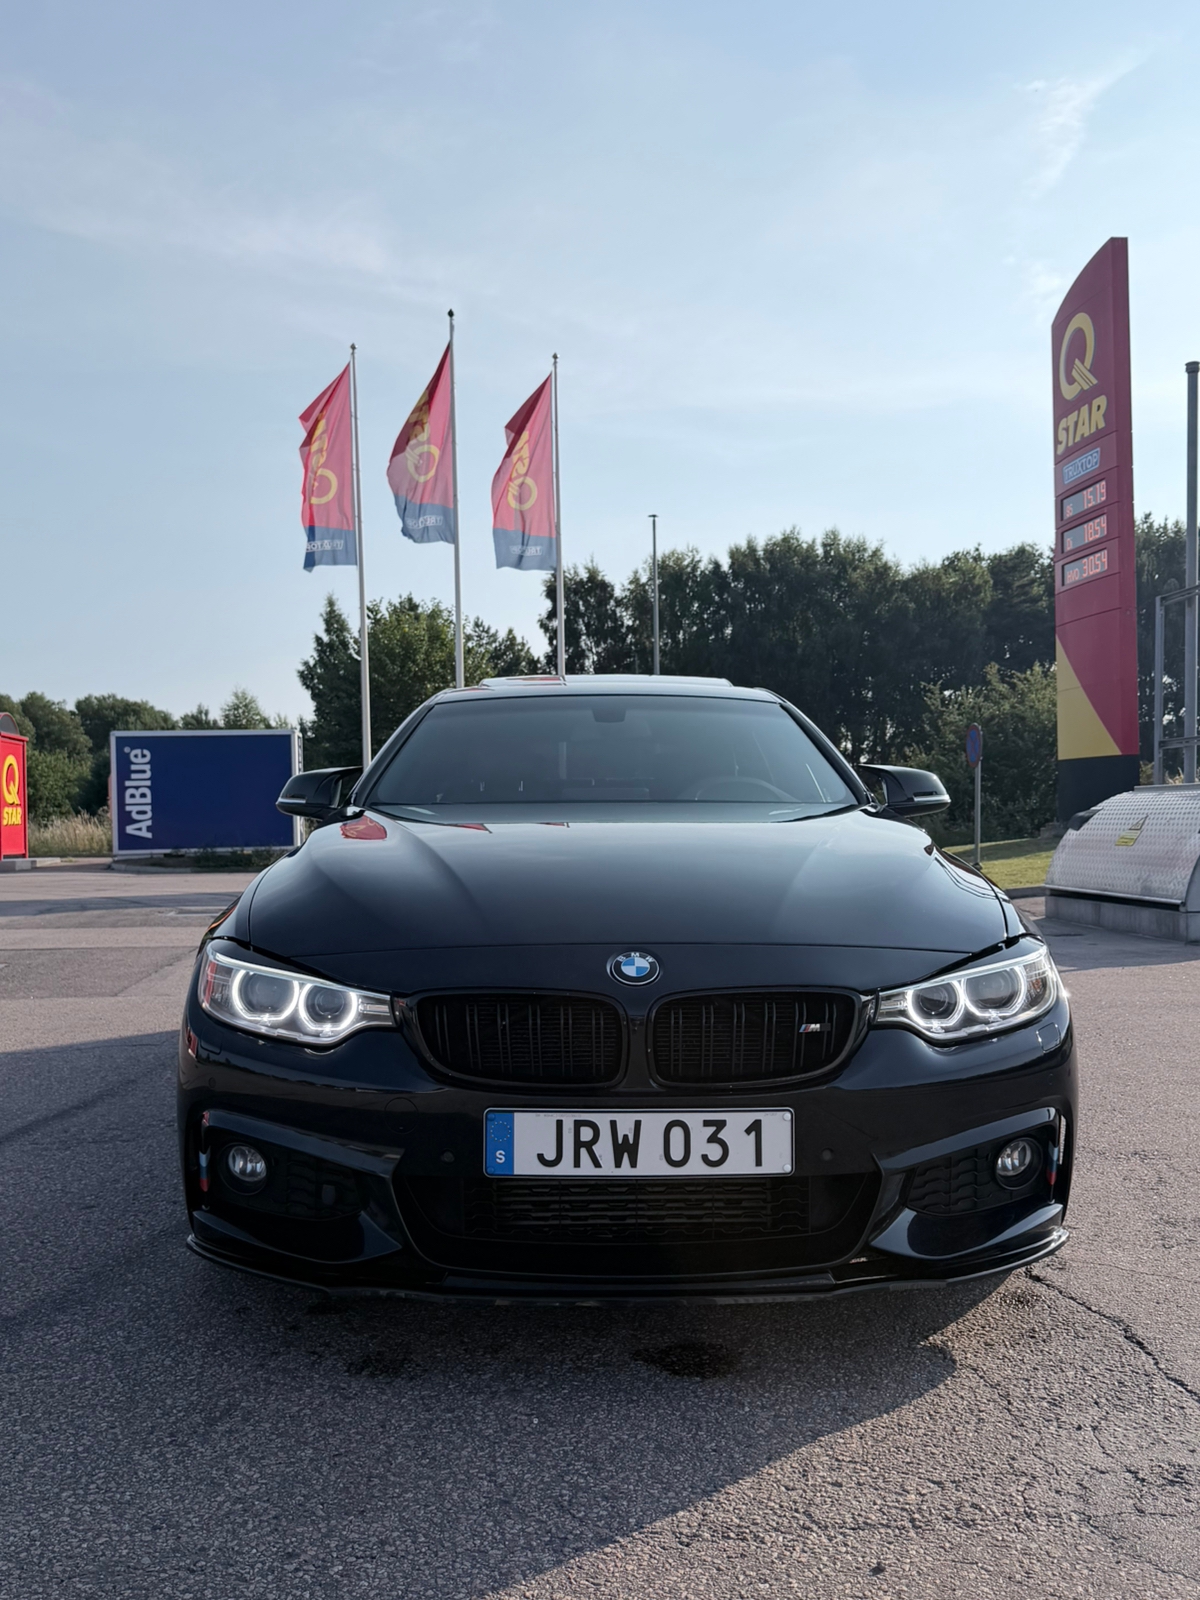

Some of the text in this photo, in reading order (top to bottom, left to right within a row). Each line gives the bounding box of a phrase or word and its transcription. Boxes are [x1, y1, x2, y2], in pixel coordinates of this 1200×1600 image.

[1059, 312, 1098, 400] Q
[1056, 395, 1107, 455] STAR
[1064, 451, 1099, 481] TRUXTOP
[3, 754, 21, 805] Q
[125, 749, 152, 839] AdBlue
[3, 806, 22, 826] STAR
[617, 952, 655, 963] BMW
[495, 1150, 506, 1163] S
[537, 1119, 762, 1168] JRW 031
